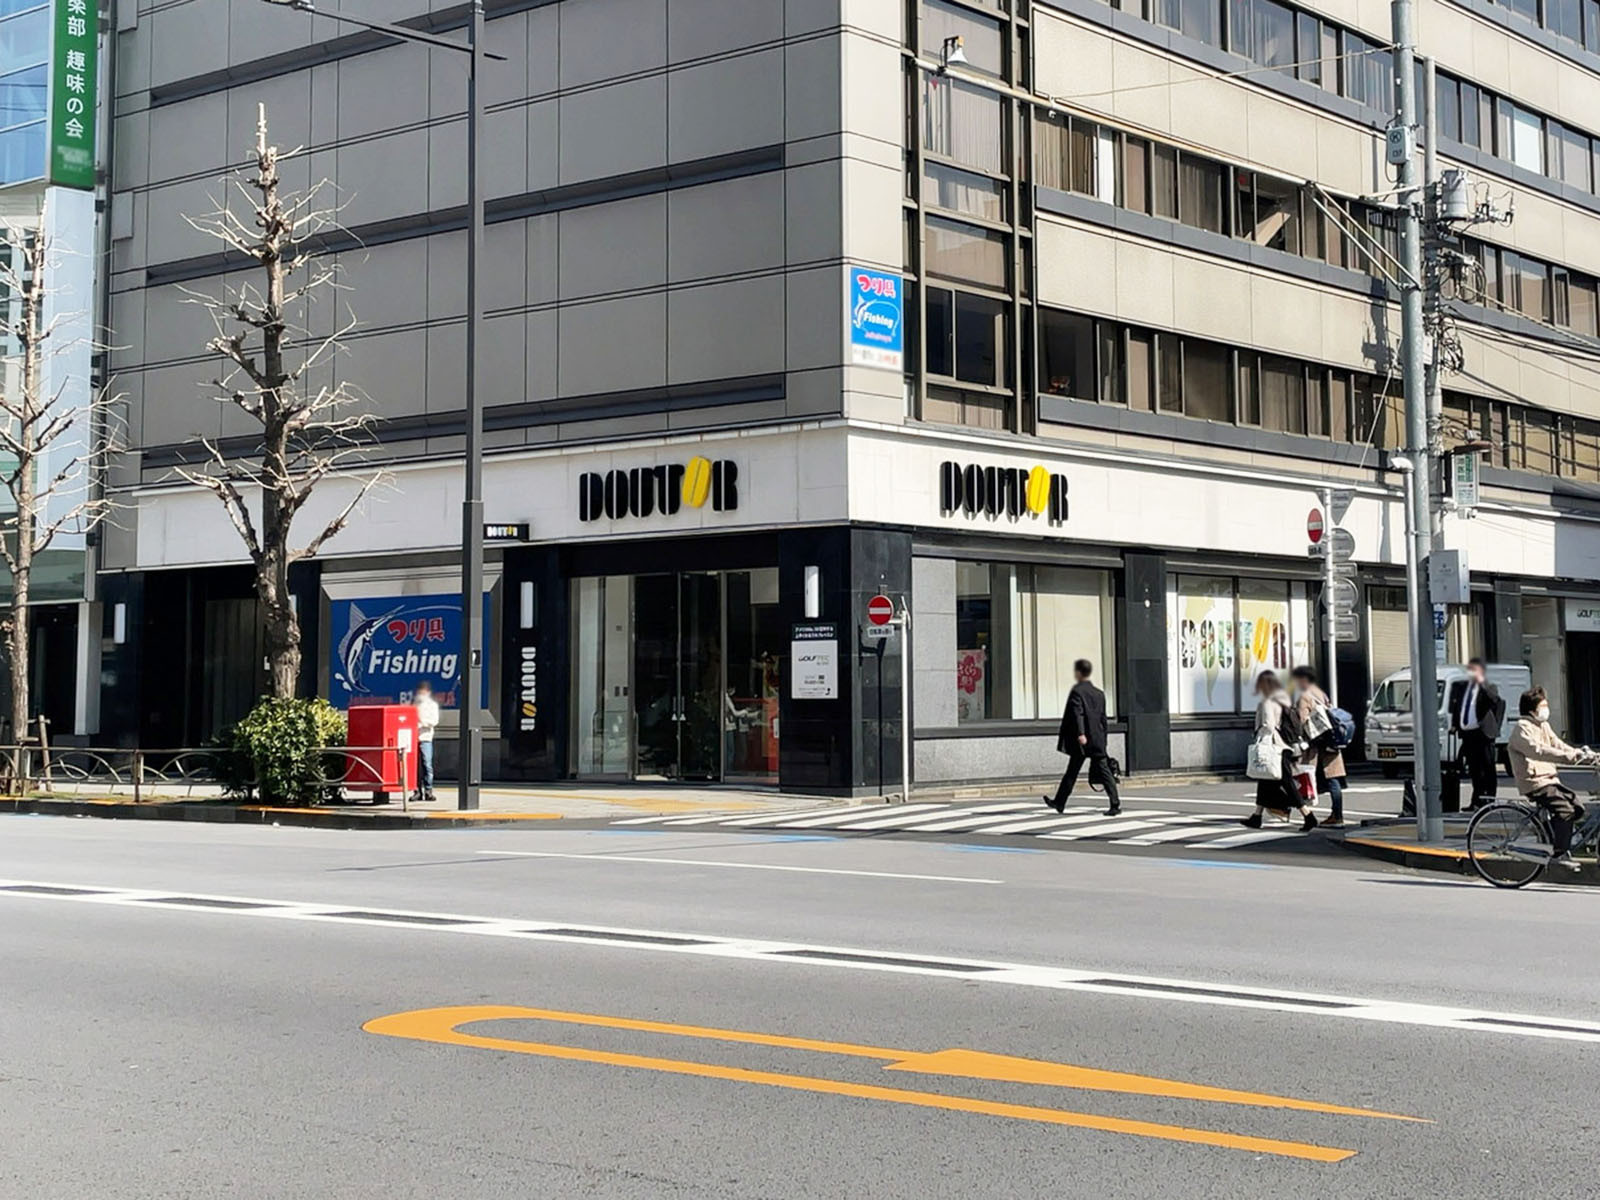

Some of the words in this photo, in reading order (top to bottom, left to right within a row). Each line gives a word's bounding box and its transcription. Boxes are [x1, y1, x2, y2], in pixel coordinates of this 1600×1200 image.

[65, 50, 86, 139] 趣味の会
[863, 311, 894, 329] Fishing
[579, 456, 738, 521] DOUTOR
[940, 461, 1069, 524] DOUTOR
[387, 617, 446, 643] つり具
[368, 649, 457, 679] Fishing
[521, 646, 537, 731] DOUTOR
